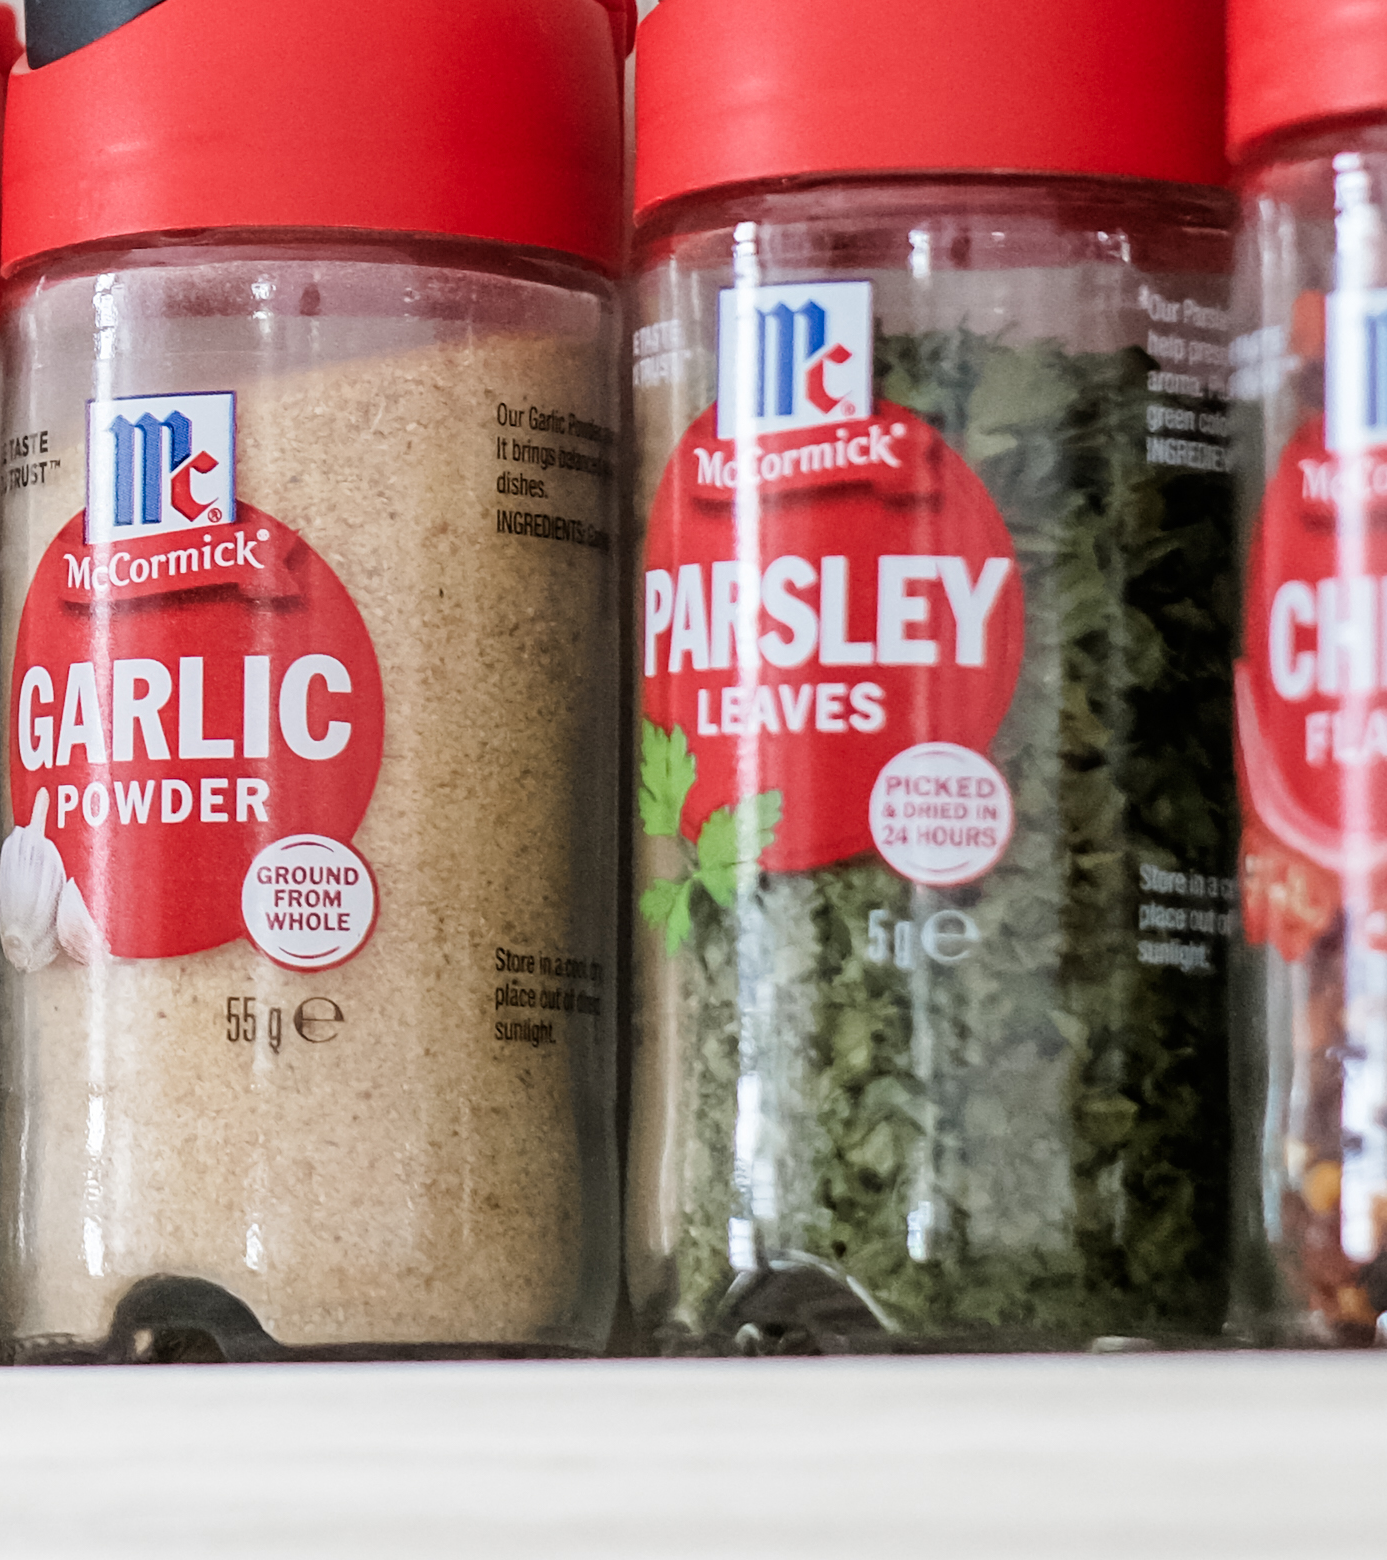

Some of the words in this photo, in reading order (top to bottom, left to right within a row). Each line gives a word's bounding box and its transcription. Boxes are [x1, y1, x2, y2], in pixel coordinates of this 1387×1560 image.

[497, 402, 525, 427] Our
[528, 406, 566, 435] Garlic
[9, 430, 48, 460] TASTE
[496, 436, 508, 461] It
[512, 438, 556, 471] brings
[694, 422, 905, 490] McCormick
[496, 471, 549, 500] dishes.
[64, 528, 267, 591] McCormick
[643, 554, 1013, 678] PARSLEY
[1269, 574, 1387, 703] CH
[18, 653, 353, 772] GARLIC
[697, 682, 886, 738] LEAVES
[884, 775, 997, 799] PICKED
[57, 778, 270, 829] POWDER
[882, 804, 897, 819] &
[903, 802, 968, 820] DRIED
[978, 805, 998, 821] IN
[882, 826, 909, 847] 24
[917, 826, 998, 848] HOURS
[257, 866, 359, 886] GROUND
[1139, 864, 1187, 895] Store
[274, 889, 342, 908] FROM
[266, 912, 351, 932] WHOLE
[1138, 901, 1187, 931] place
[868, 908, 888, 963] 5
[495, 946, 535, 974] Store
[539, 950, 552, 976] in
[494, 983, 536, 1011] place
[227, 996, 256, 1042] 55
[268, 1006, 283, 1054] g
[494, 1018, 557, 1049] sunlight.
